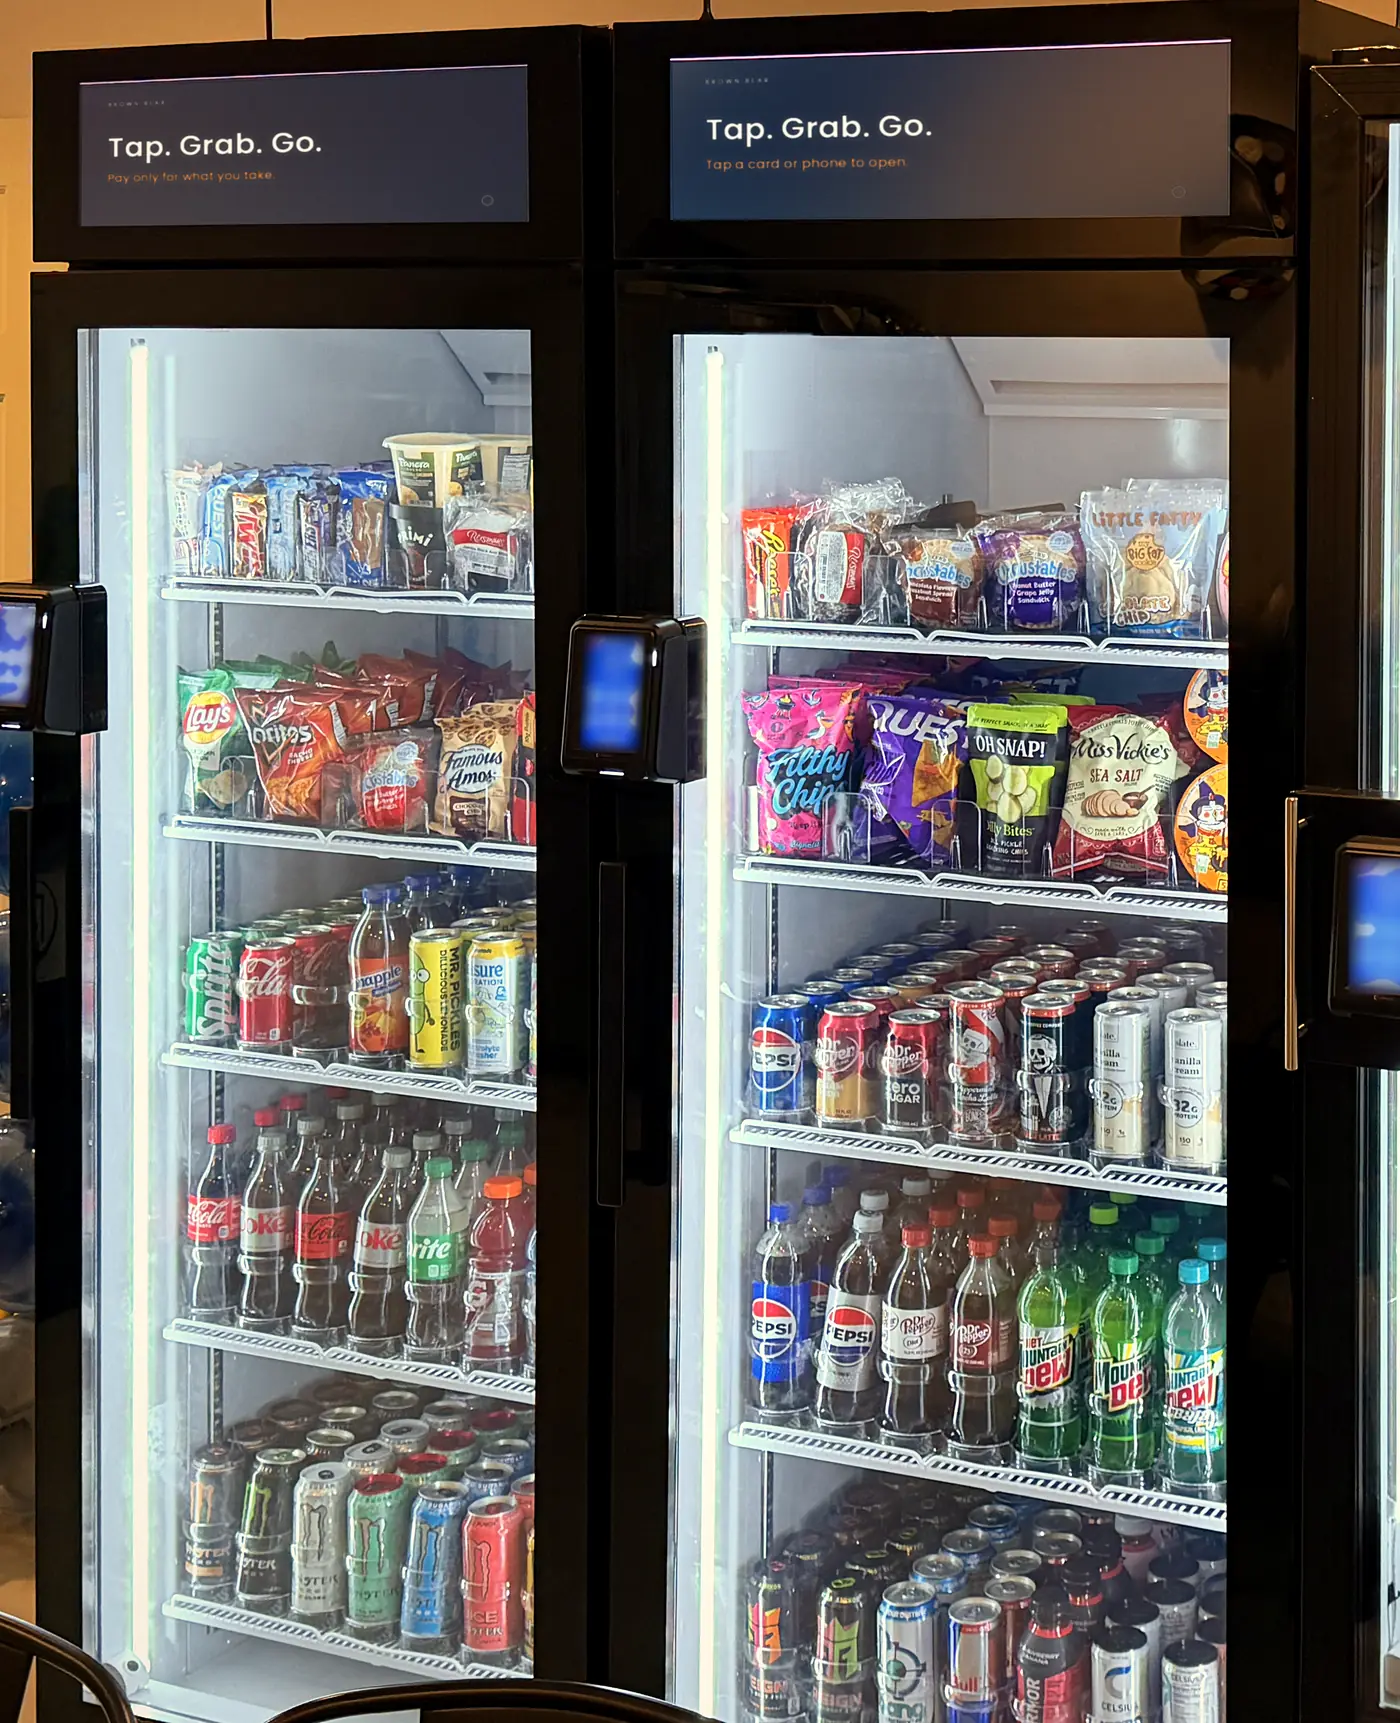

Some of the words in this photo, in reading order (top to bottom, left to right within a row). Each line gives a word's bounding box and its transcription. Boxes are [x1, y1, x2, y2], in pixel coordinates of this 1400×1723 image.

[706, 119, 773, 148] Tap.
[782, 115, 870, 139] Grab.
[879, 115, 932, 137] Go.
[109, 138, 171, 163] Tap.
[180, 133, 262, 155] Grab.
[272, 132, 322, 153] Go.
[706, 159, 732, 172] Tap
[735, 160, 744, 169] a
[748, 158, 780, 170] card
[784, 160, 797, 168] or
[802, 157, 847, 172] phone
[851, 157, 865, 168] to
[107, 173, 129, 185] Pay
[133, 173, 158, 186] only
[162, 171, 178, 182] for
[183, 171, 213, 182] what
[217, 173, 240, 184] you
[183, 702, 231, 733] Lay's
[866, 699, 968, 749] QUES
[974, 735, 995, 753] OH
[997, 737, 1046, 758] SNAP!
[1070, 737, 1113, 761] Miss
[1112, 732, 1173, 765] Vickie's
[446, 750, 503, 779] Famous
[766, 744, 850, 783] Filthy
[1089, 767, 1110, 784] SEA
[1114, 767, 1144, 783] SALT
[1003, 822, 1033, 838] Bites
[449, 982, 461, 1051] PICKLES
[754, 1053, 798, 1068] EPSI
[1174, 1056, 1201, 1066] anilla
[1174, 1066, 1200, 1076] ream
[244, 1212, 285, 1235] oke
[360, 1228, 401, 1250] oke
[412, 1237, 451, 1261] rite
